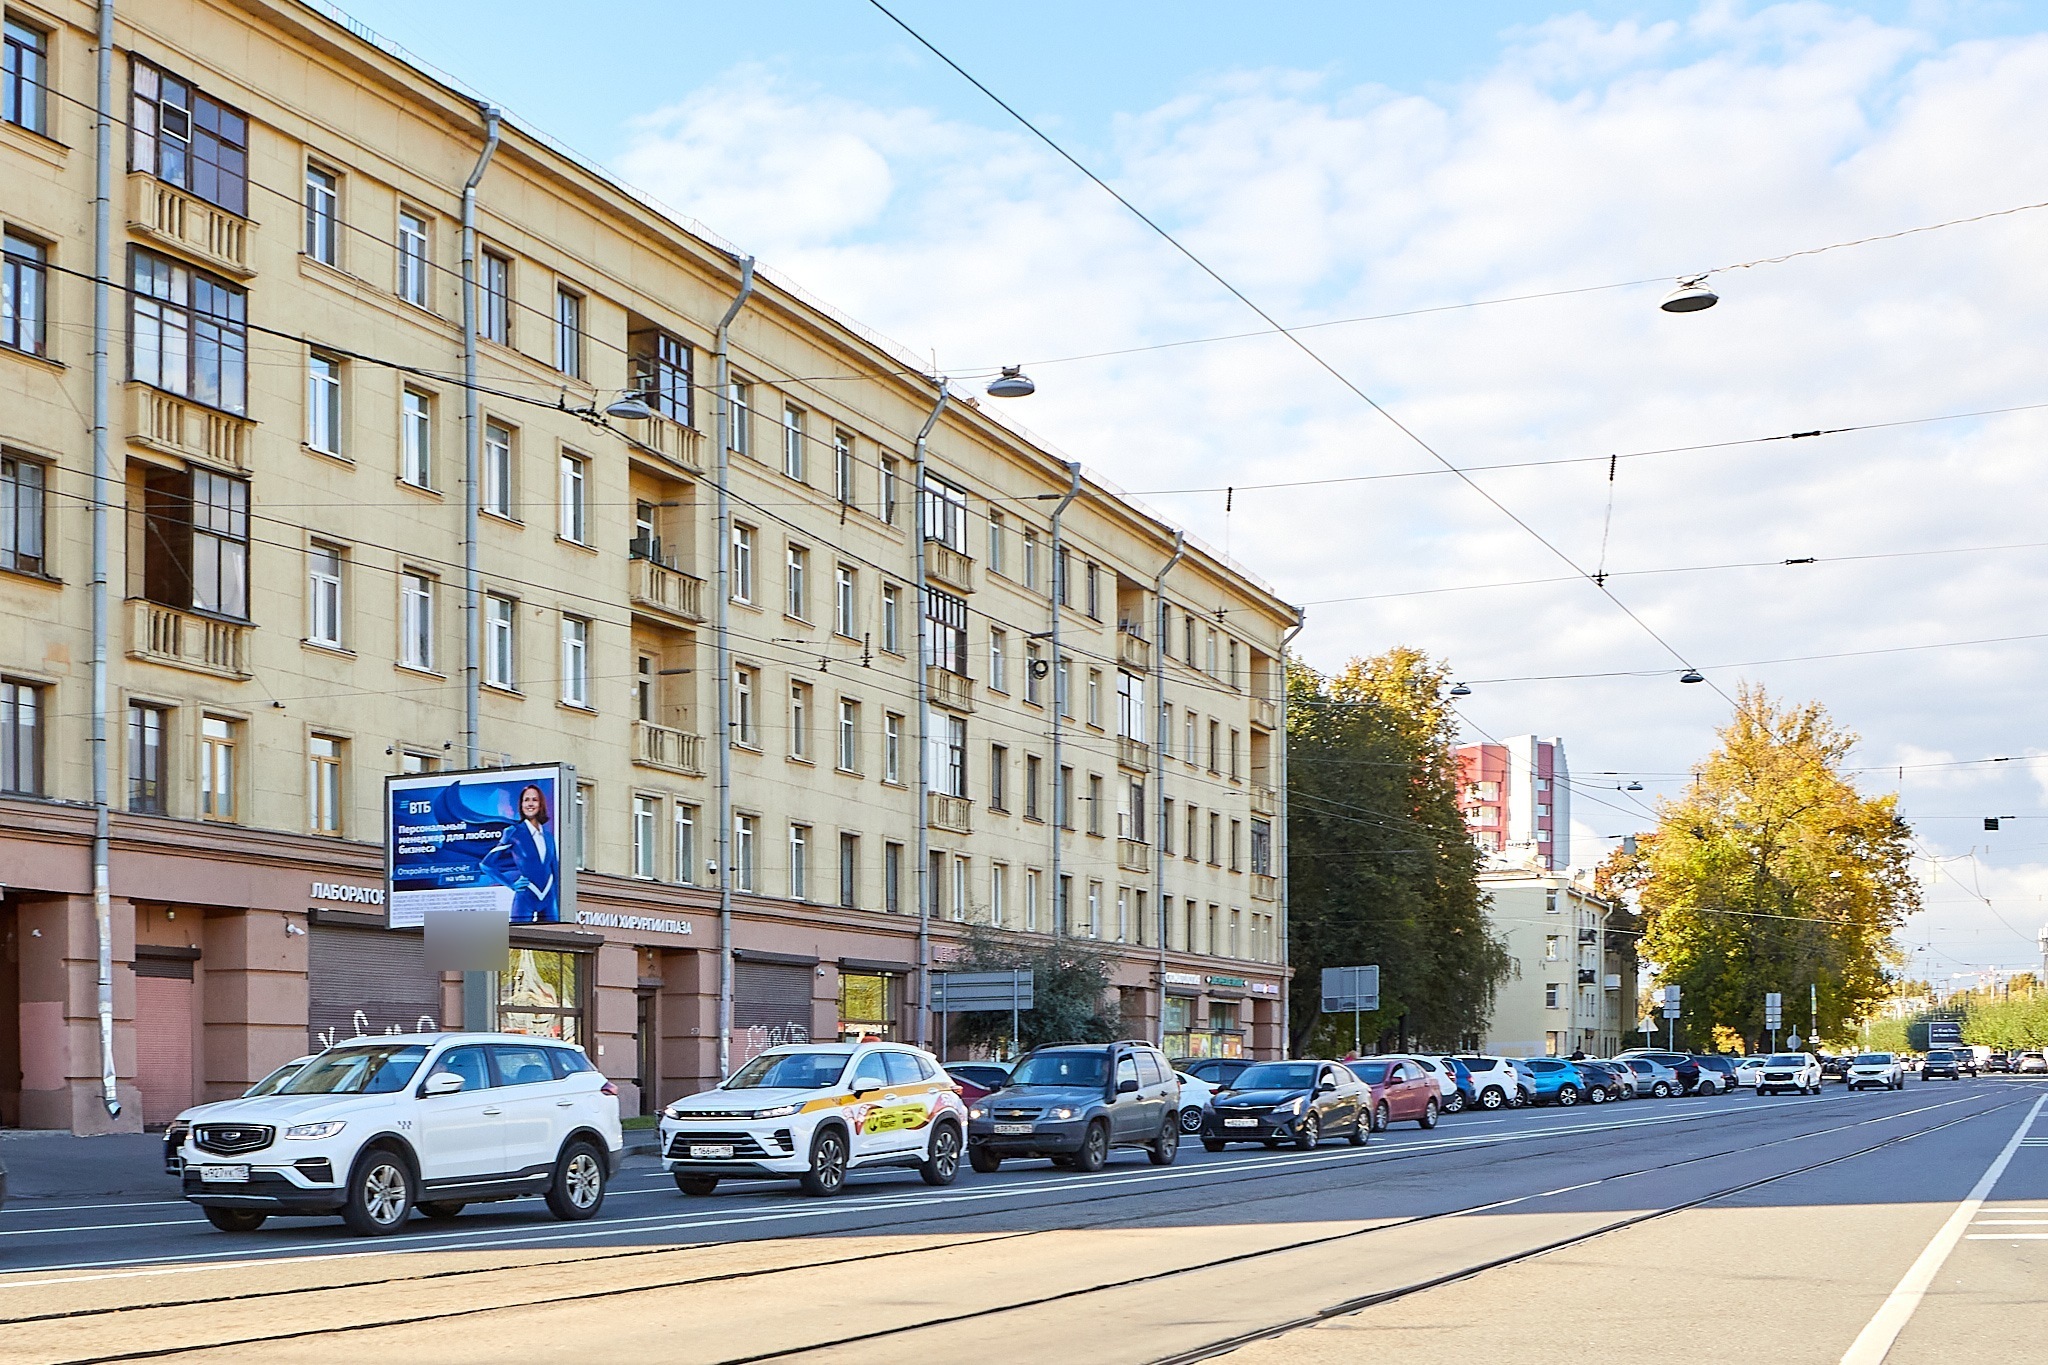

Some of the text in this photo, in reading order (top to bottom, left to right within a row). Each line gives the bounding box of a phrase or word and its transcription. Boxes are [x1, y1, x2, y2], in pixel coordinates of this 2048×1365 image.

[409, 801, 431, 815] ВТБ
[398, 822, 467, 834] Персональный
[398, 829, 502, 844] менеджер для любого
[398, 845, 435, 854] бизнеса
[397, 866, 429, 875] Откройте
[619, 914, 665, 932] ХИРУРГИИ
[665, 919, 692, 934] ГЛАЗА
